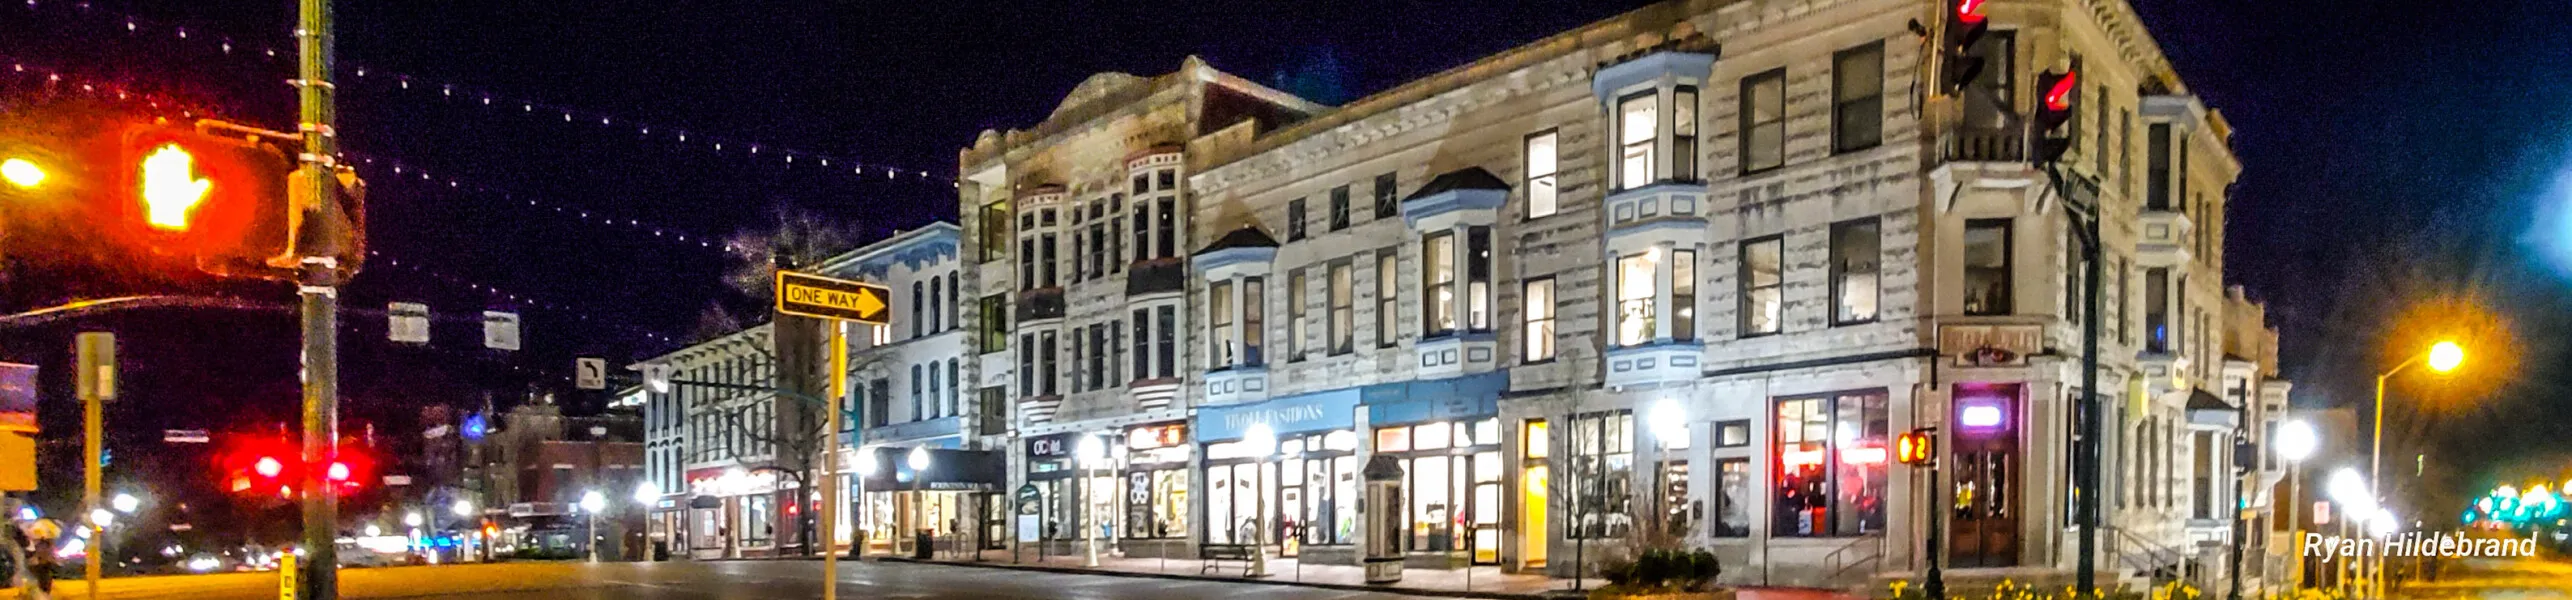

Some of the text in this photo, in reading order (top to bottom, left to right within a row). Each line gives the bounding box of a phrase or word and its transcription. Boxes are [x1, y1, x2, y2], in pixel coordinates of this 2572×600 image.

[791, 286, 859, 308] ONE WAY
[1265, 404, 1324, 424] FASHIONS
[1915, 436, 1926, 460] 2
